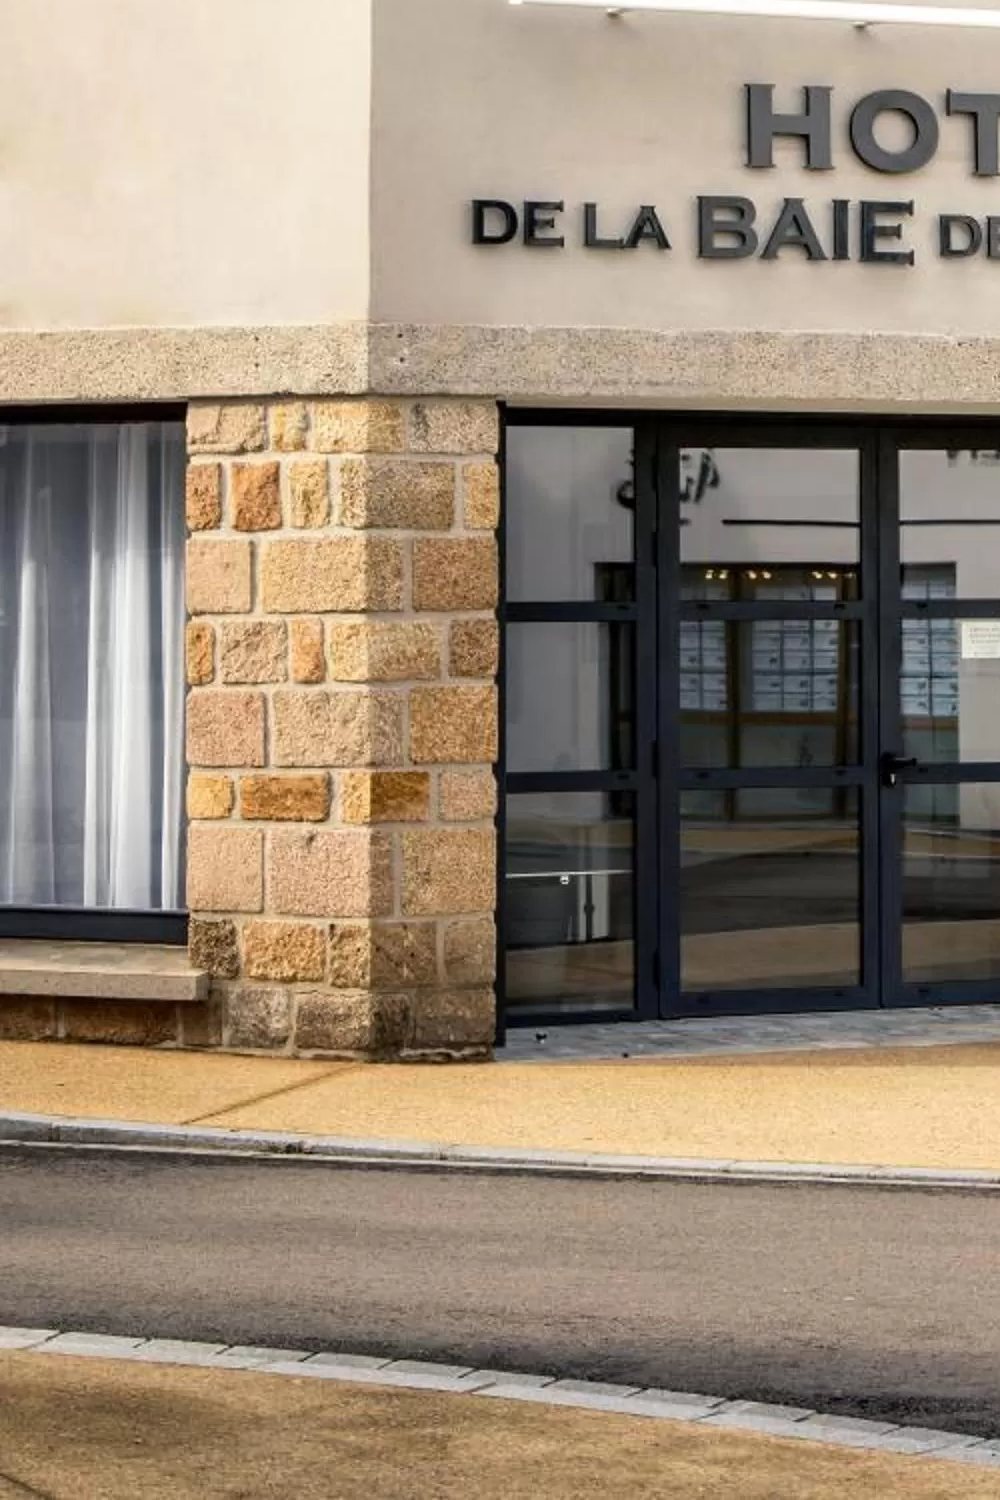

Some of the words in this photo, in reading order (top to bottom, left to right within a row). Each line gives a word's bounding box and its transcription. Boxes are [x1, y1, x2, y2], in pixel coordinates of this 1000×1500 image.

[470, 199, 565, 247] DE
[583, 202, 672, 250] LA
[696, 194, 915, 267] BAIE
